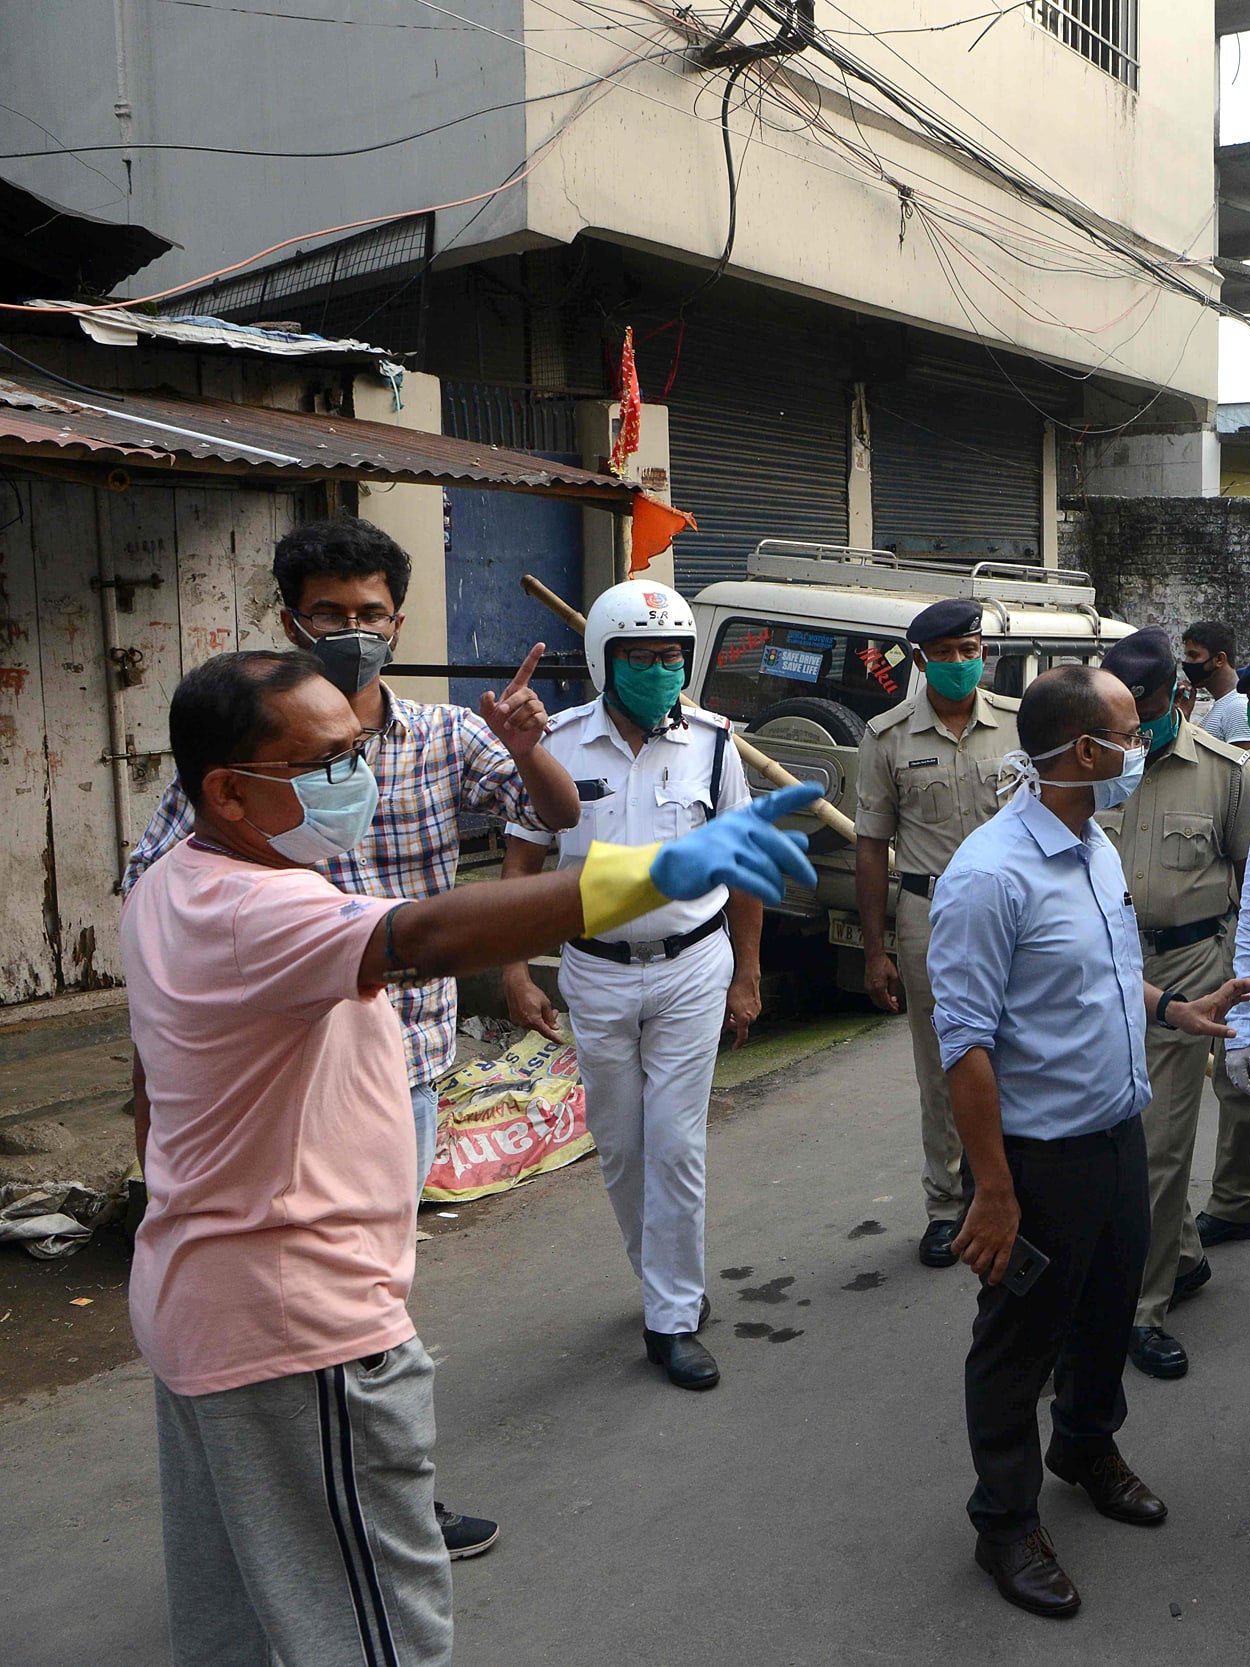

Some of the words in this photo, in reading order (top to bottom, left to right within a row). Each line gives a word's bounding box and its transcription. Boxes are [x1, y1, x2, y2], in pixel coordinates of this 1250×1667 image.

[782, 651, 800, 662] SAFE
[799, 654, 821, 666] DRIVE
[782, 661, 801, 672] SAVE
[802, 664, 818, 675] LIFE
[855, 647, 899, 695] Miku
